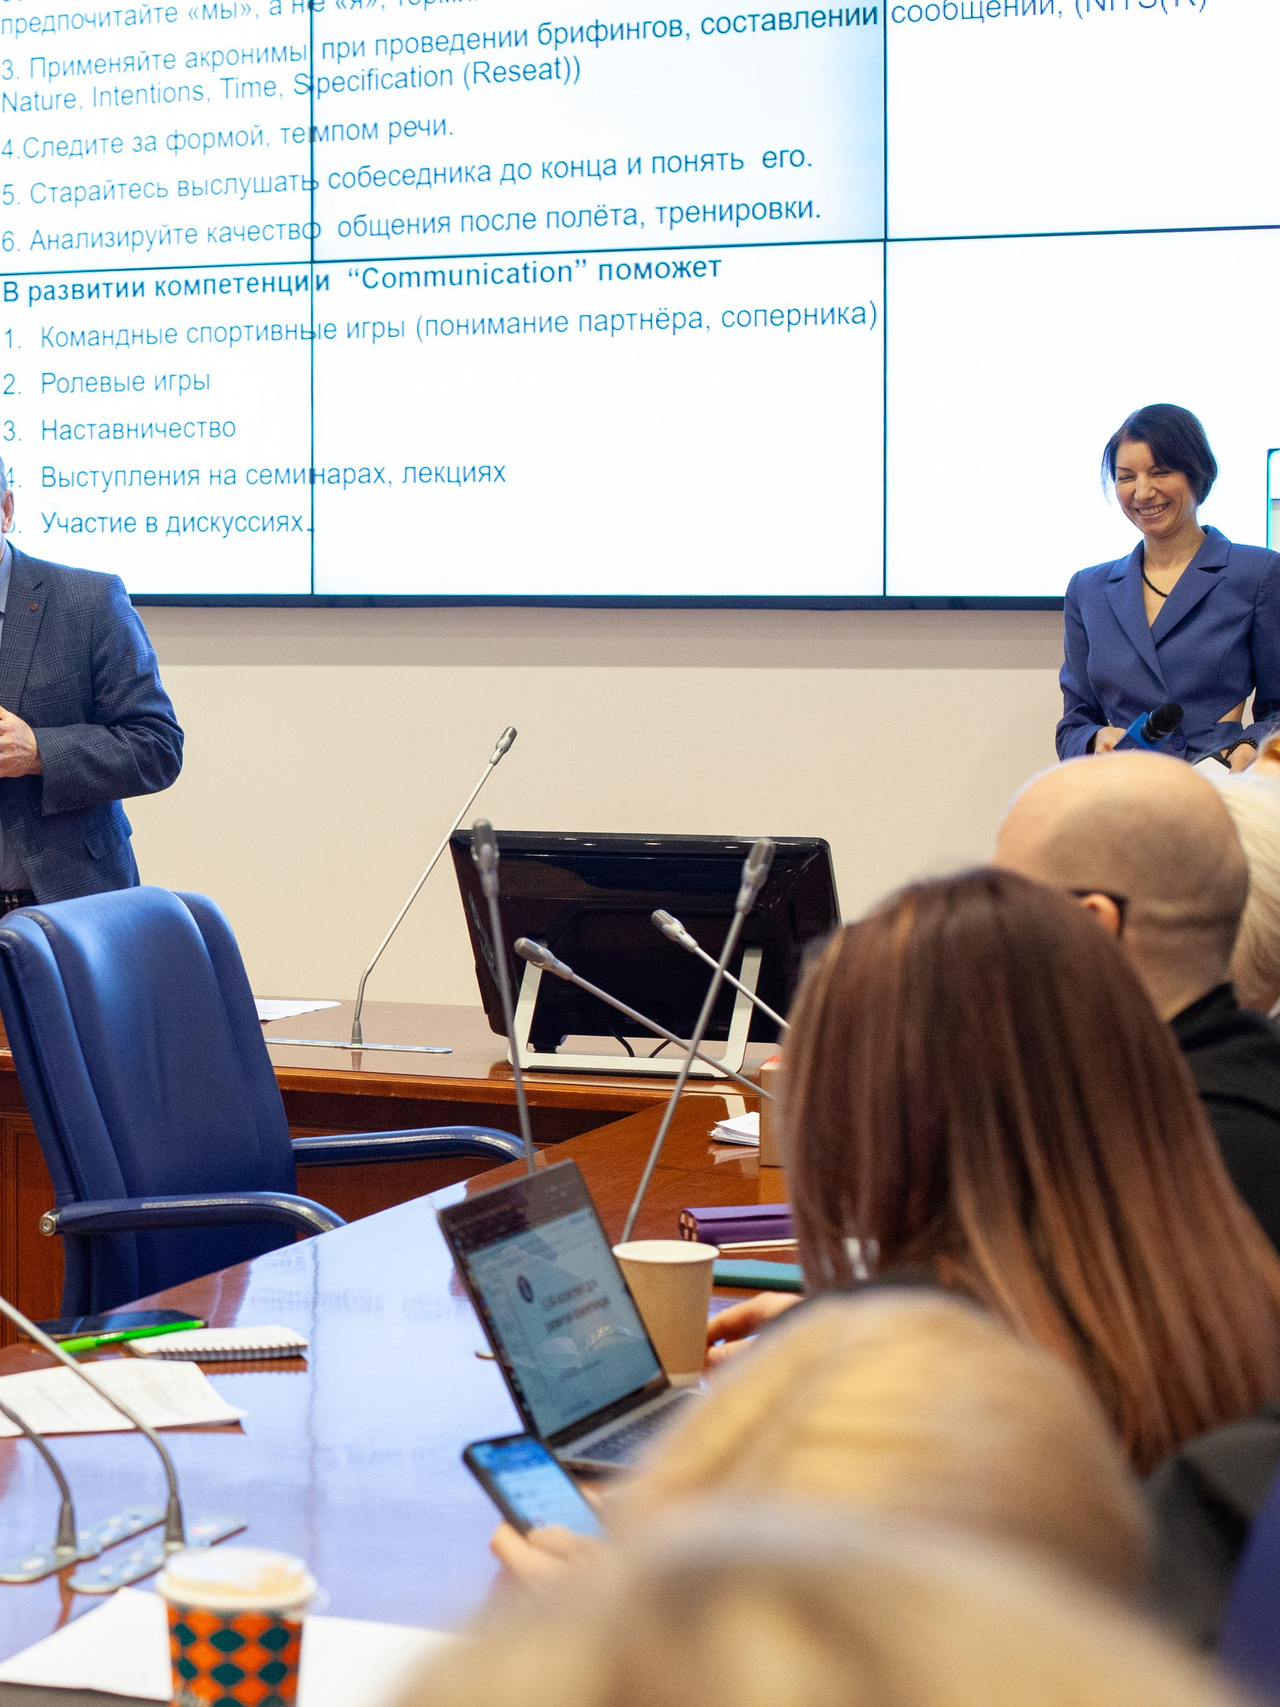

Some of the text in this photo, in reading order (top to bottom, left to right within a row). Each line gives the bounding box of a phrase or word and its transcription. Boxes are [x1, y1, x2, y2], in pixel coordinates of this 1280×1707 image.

[2, 3, 178, 39] предпочитайте
[269, 0, 282, 15] а
[2, 59, 19, 80] 3.
[30, 51, 176, 81] Применяйте
[185, 44, 307, 70] акронимы
[322, 40, 366, 64] при
[375, 29, 528, 60] проведении
[537, 19, 690, 50] брифингов,
[701, 6, 878, 35] составлении
[2, 55, 580, 113] Nature, Intentions, Time, Specification (Reseat))
[1, 118, 453, 160] 4.Следите за формой, темпом речи.
[2, 149, 812, 208] 5. Старайтесь выслушать собеседника до конца и понять его.
[2, 200, 821, 253] 6. Анализируйте качество общения после полёта, тренировки.
[3, 281, 19, 302] В
[28, 281, 145, 307] развитии
[155, 274, 330, 297] компетенции
[598, 259, 722, 281] поможет
[5, 300, 877, 349] 1. Командные спортивные игры (понимание партнёра, соперника)
[3, 372, 209, 397] 2. Ролевые игры
[3, 419, 236, 442] 3. Наставничество
[42, 466, 199, 493] Выступления
[210, 469, 236, 485] на
[246, 467, 392, 491] семинарах,
[402, 465, 506, 487] лекциях
[41, 511, 137, 533] Участие
[145, 516, 158, 533] в
[166, 515, 314, 539] дискуссиях.
